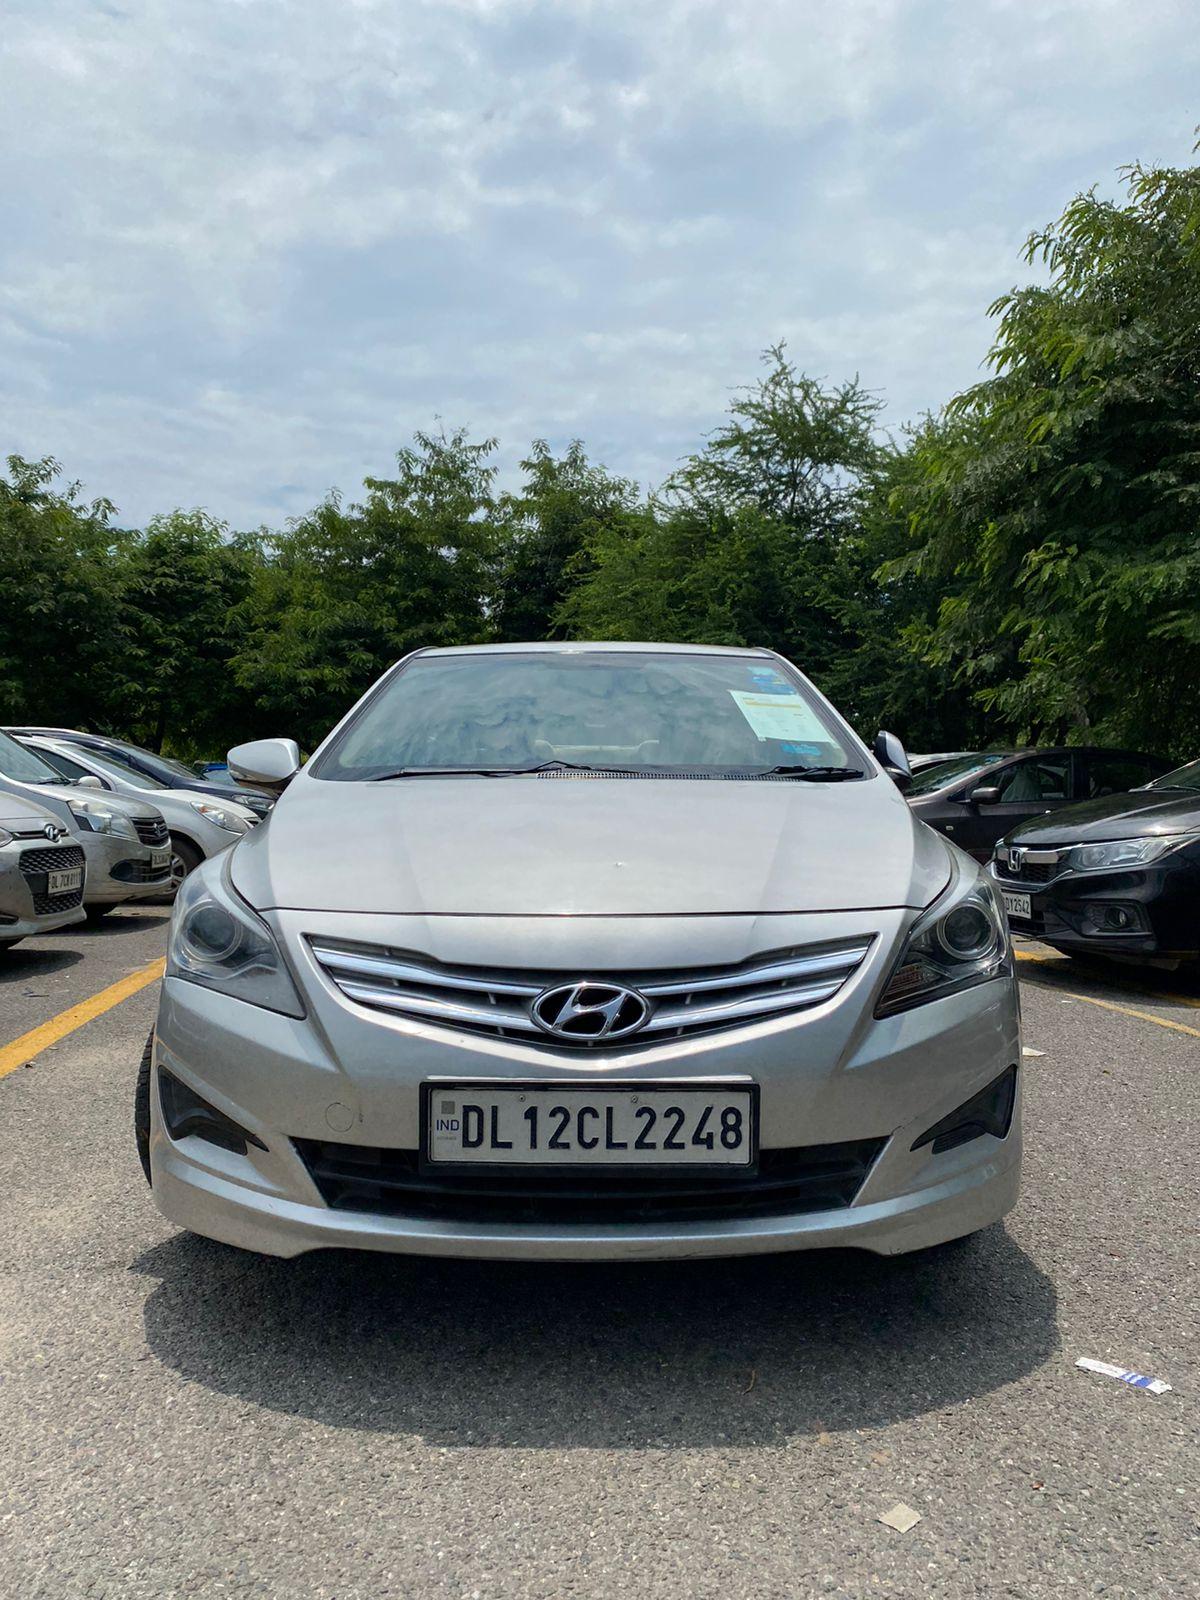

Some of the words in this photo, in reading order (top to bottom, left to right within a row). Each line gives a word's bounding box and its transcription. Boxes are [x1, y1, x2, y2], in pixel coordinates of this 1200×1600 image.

[1003, 896, 1030, 915] DY2542
[436, 1119, 459, 1132] IND
[462, 1105, 743, 1150] DL12CL2248
